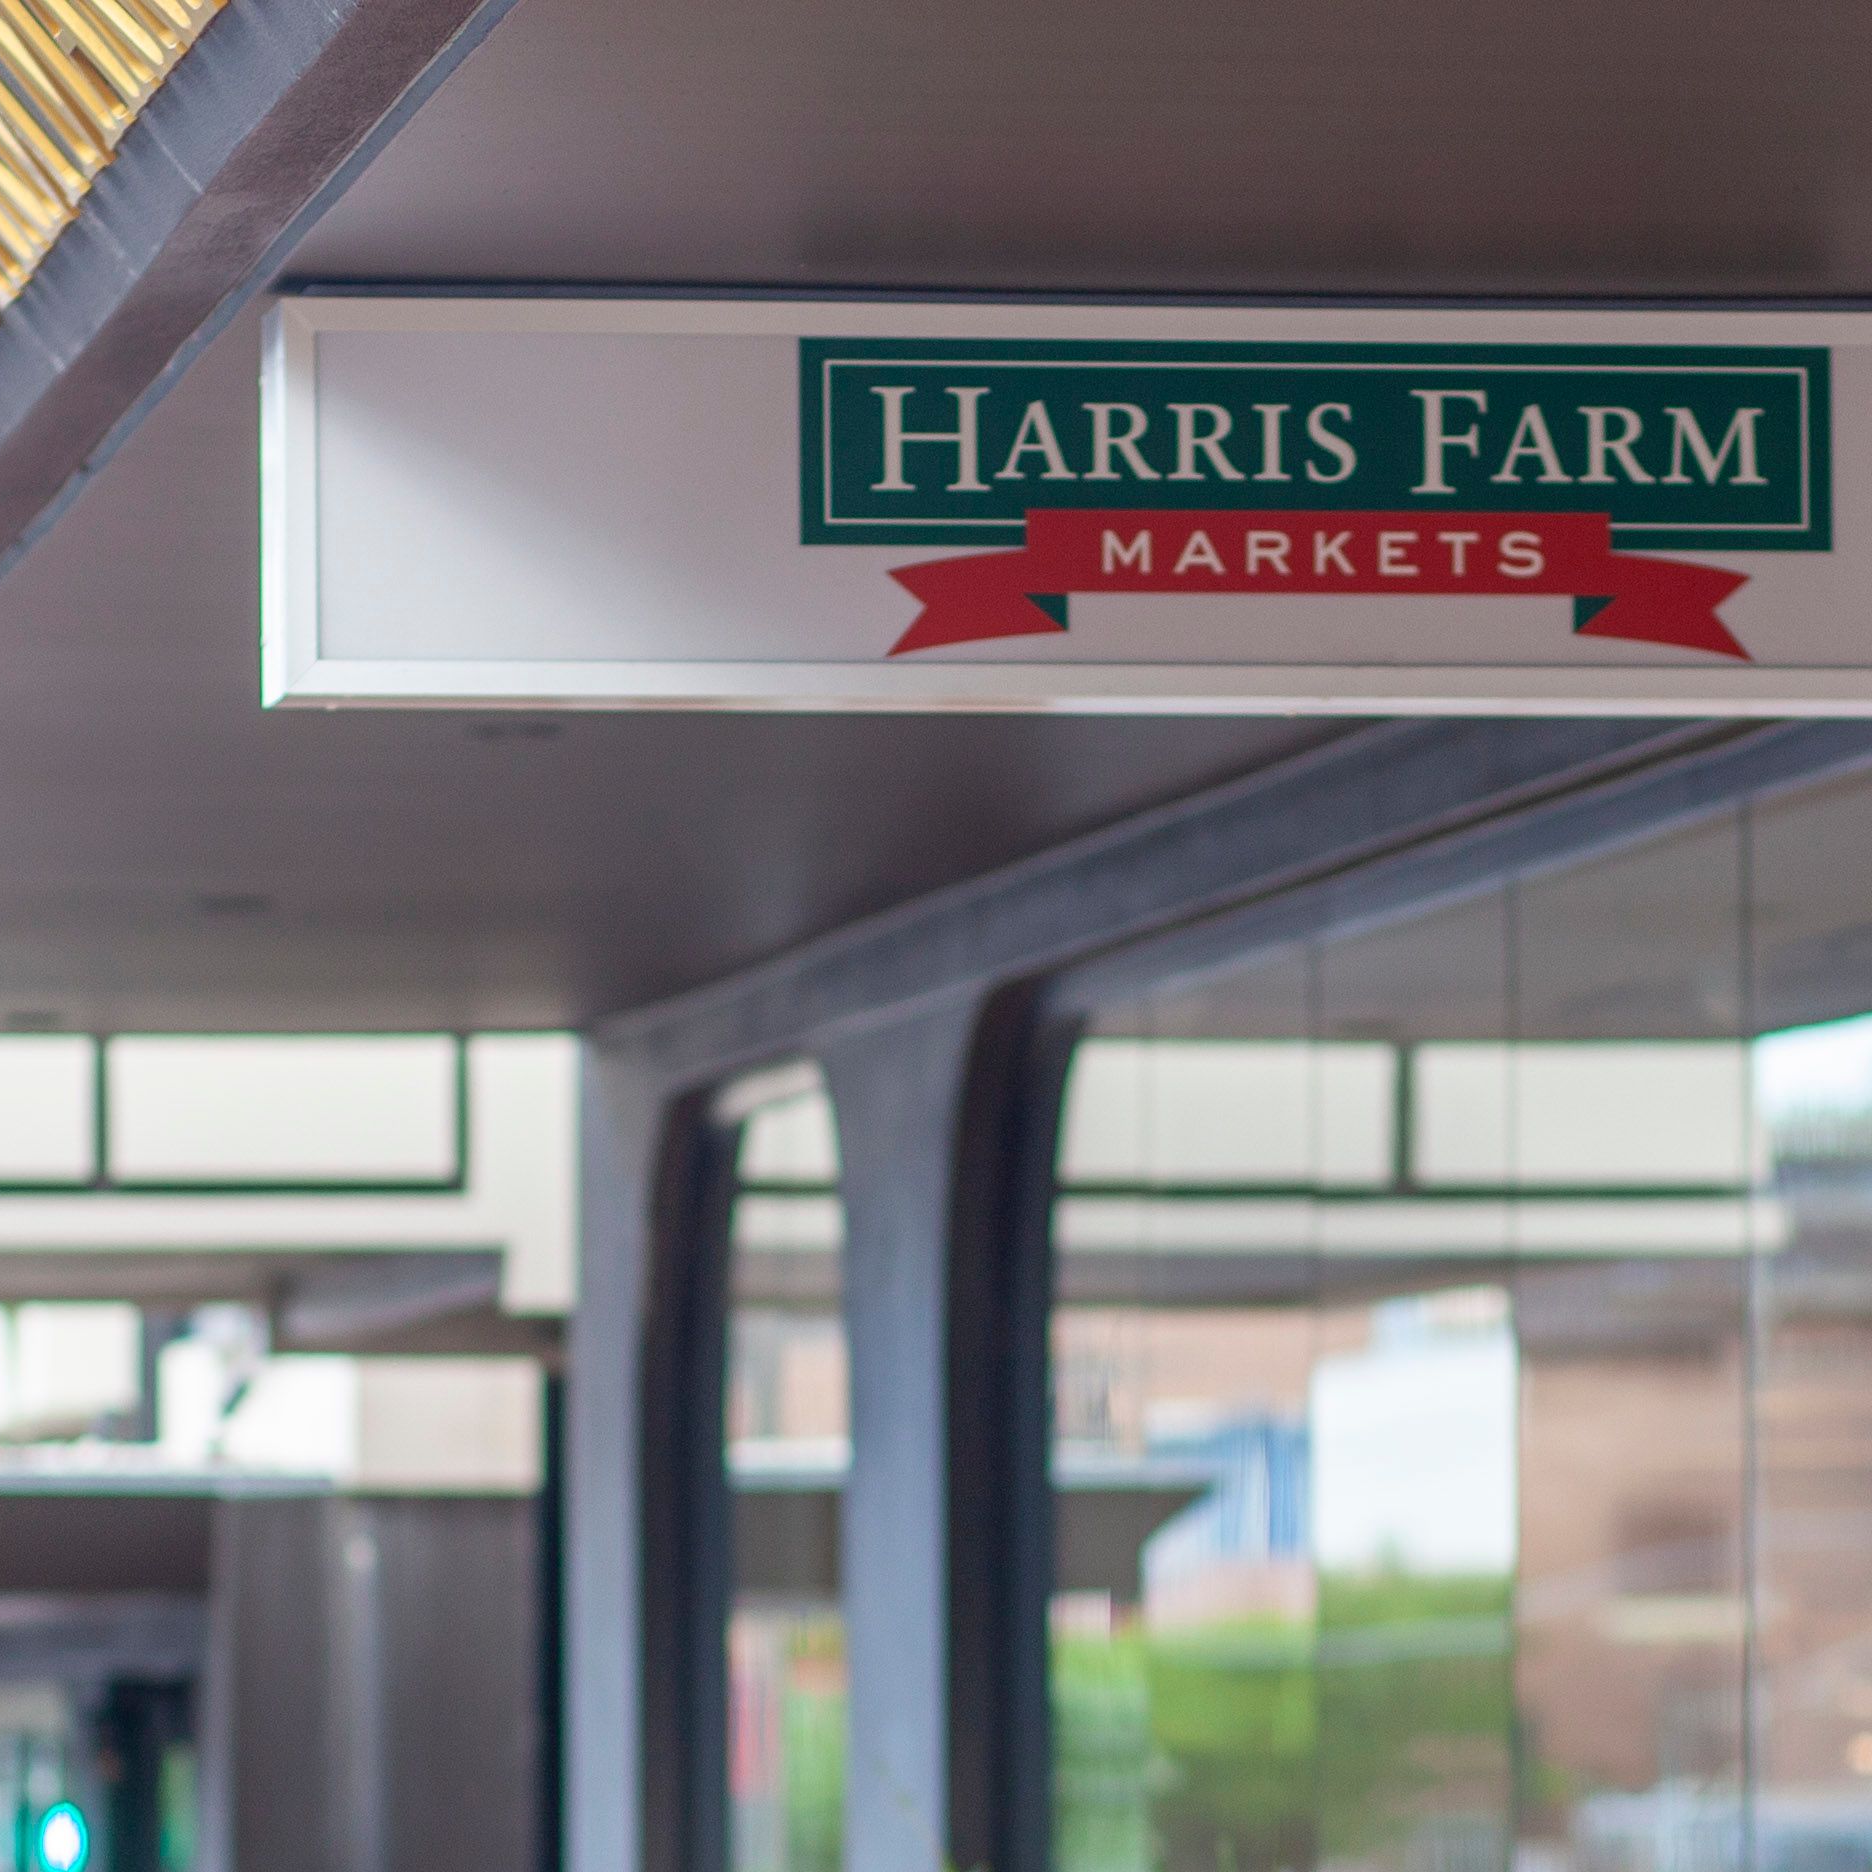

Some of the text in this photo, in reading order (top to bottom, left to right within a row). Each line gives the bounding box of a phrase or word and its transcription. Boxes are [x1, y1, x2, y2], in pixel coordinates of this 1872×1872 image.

[869, 386, 1770, 495] HARRIS FARM
[1100, 528, 1545, 578] MARKETS
